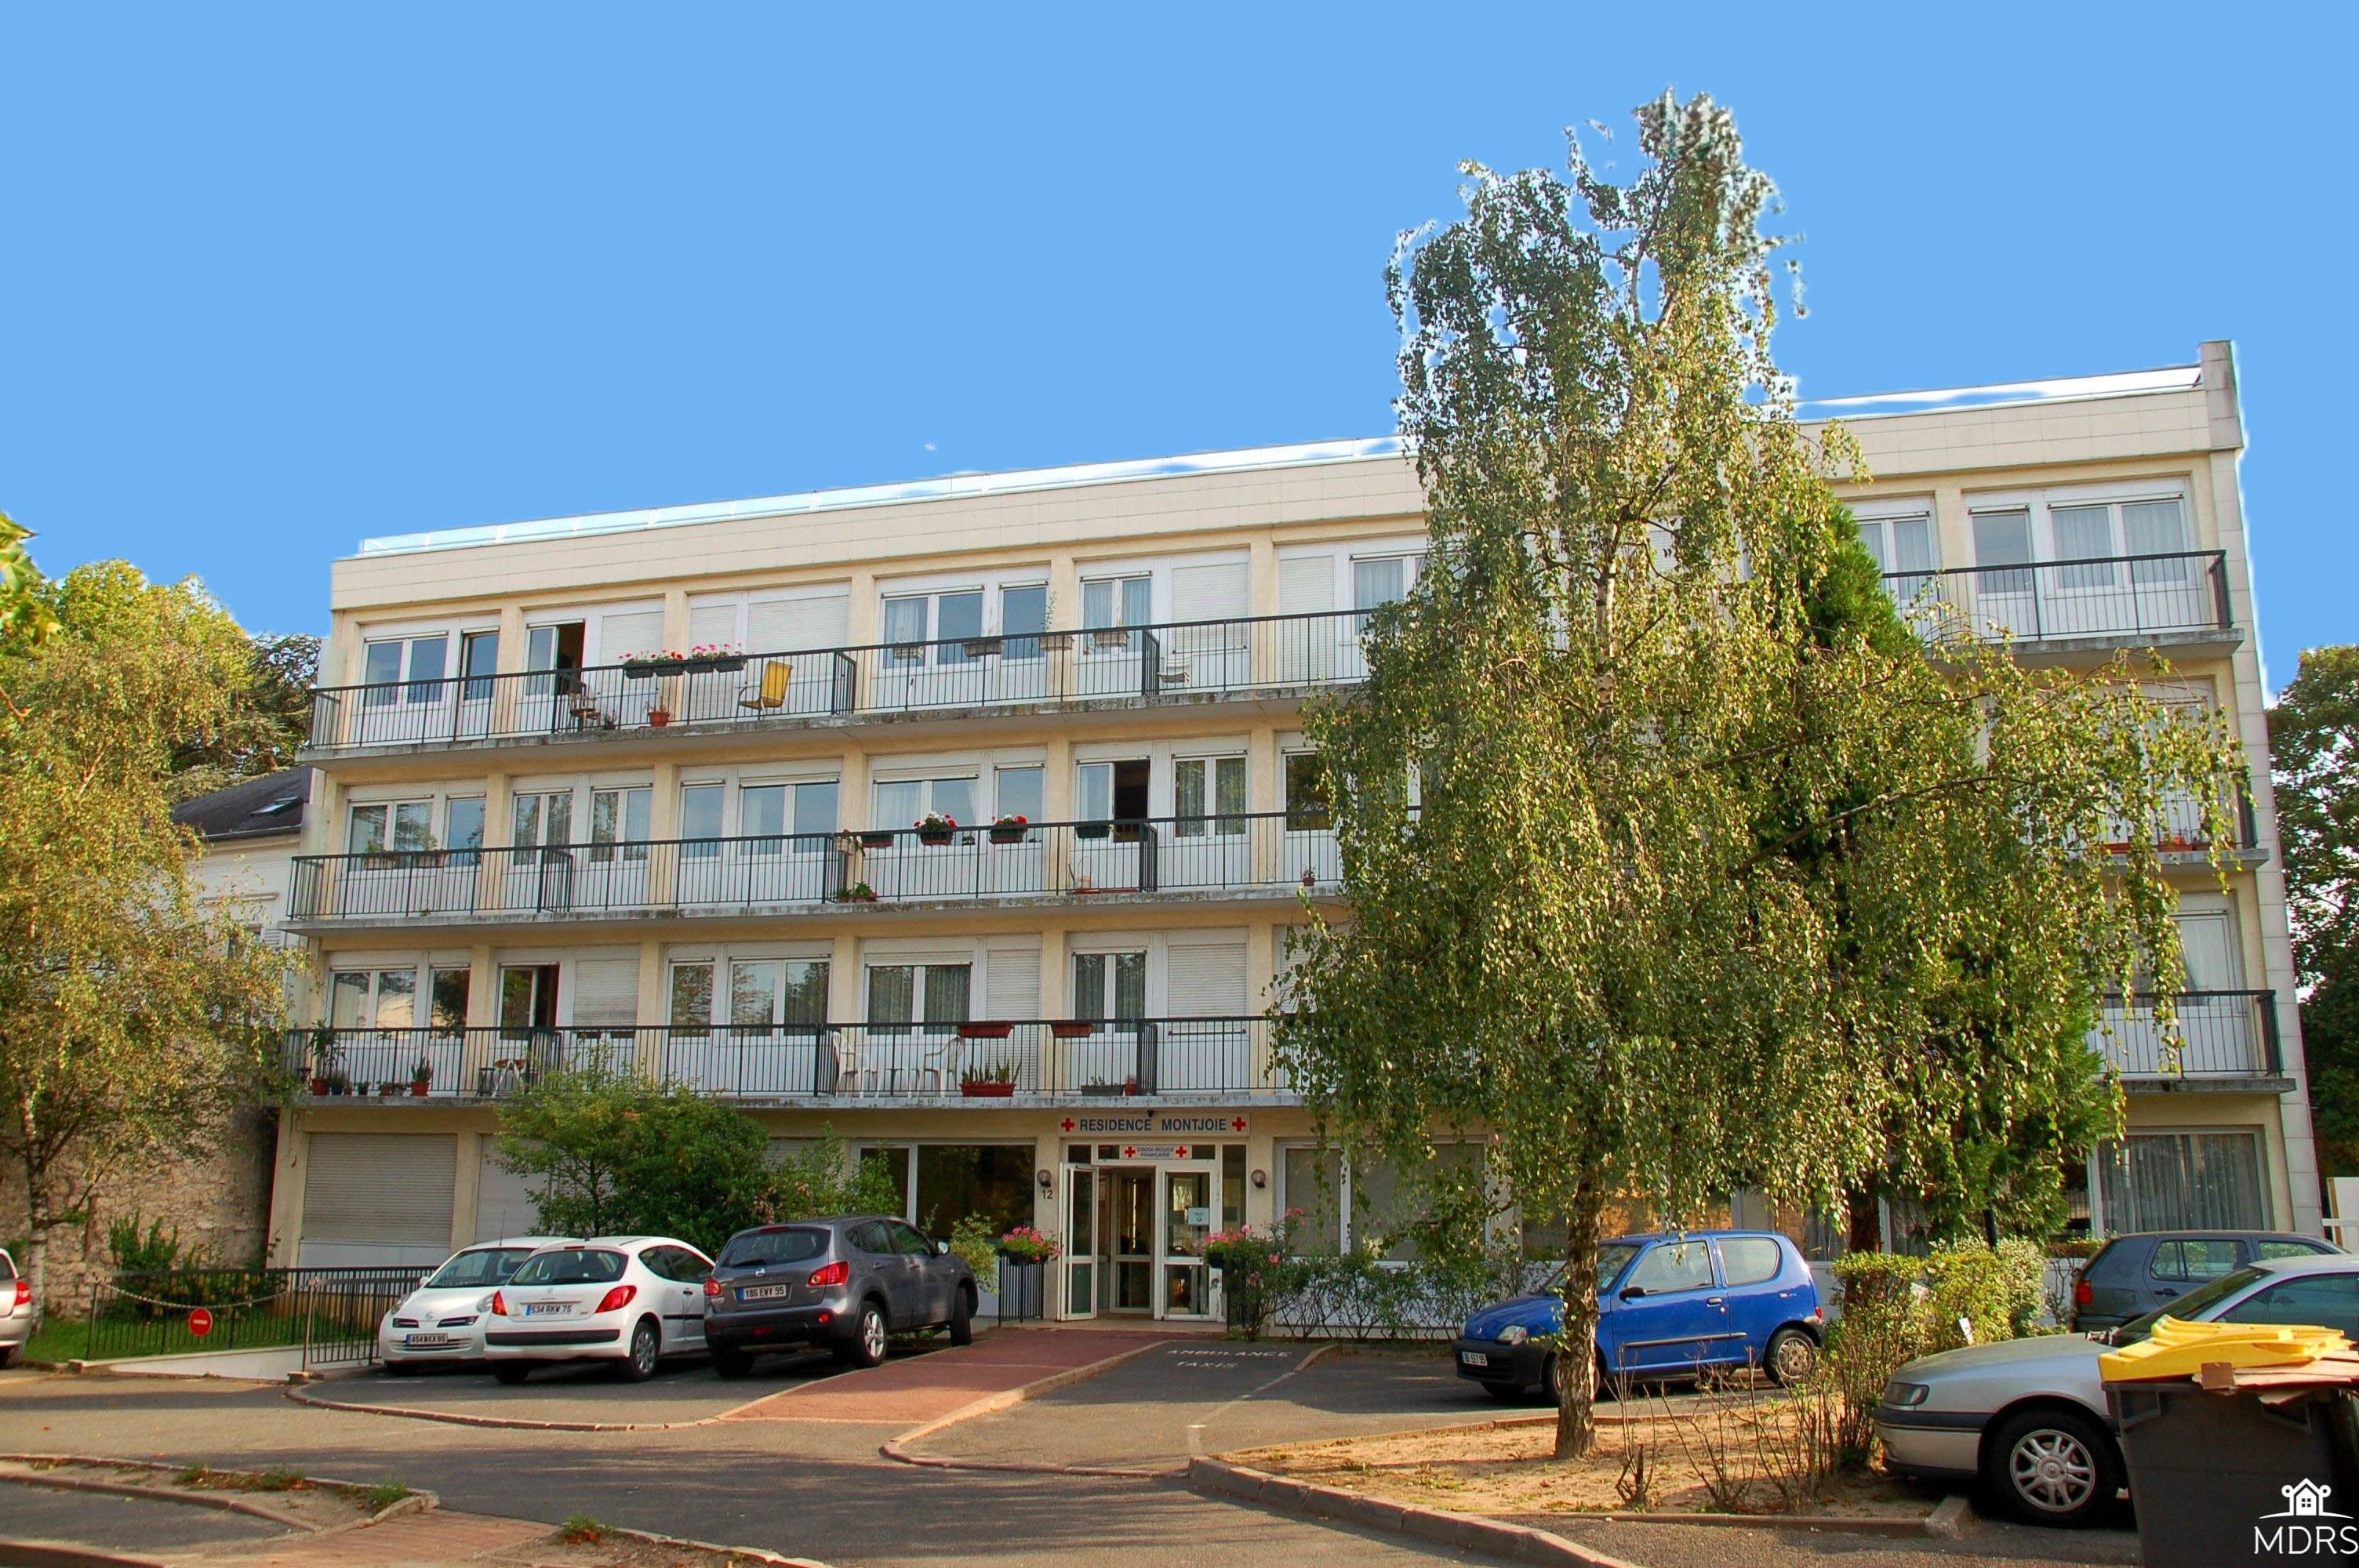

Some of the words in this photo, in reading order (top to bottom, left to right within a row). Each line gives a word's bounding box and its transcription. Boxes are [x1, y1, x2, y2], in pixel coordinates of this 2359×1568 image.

[1079, 1118, 1152, 1131] RESIDENCE
[1161, 1117, 1227, 1131] MONTJOIE
[1041, 1189, 1053, 1200] 12
[775, 1285, 784, 1295] 95
[1166, 1349, 1292, 1358] AMBULANCE
[1177, 1360, 1238, 1369] TAXIS
